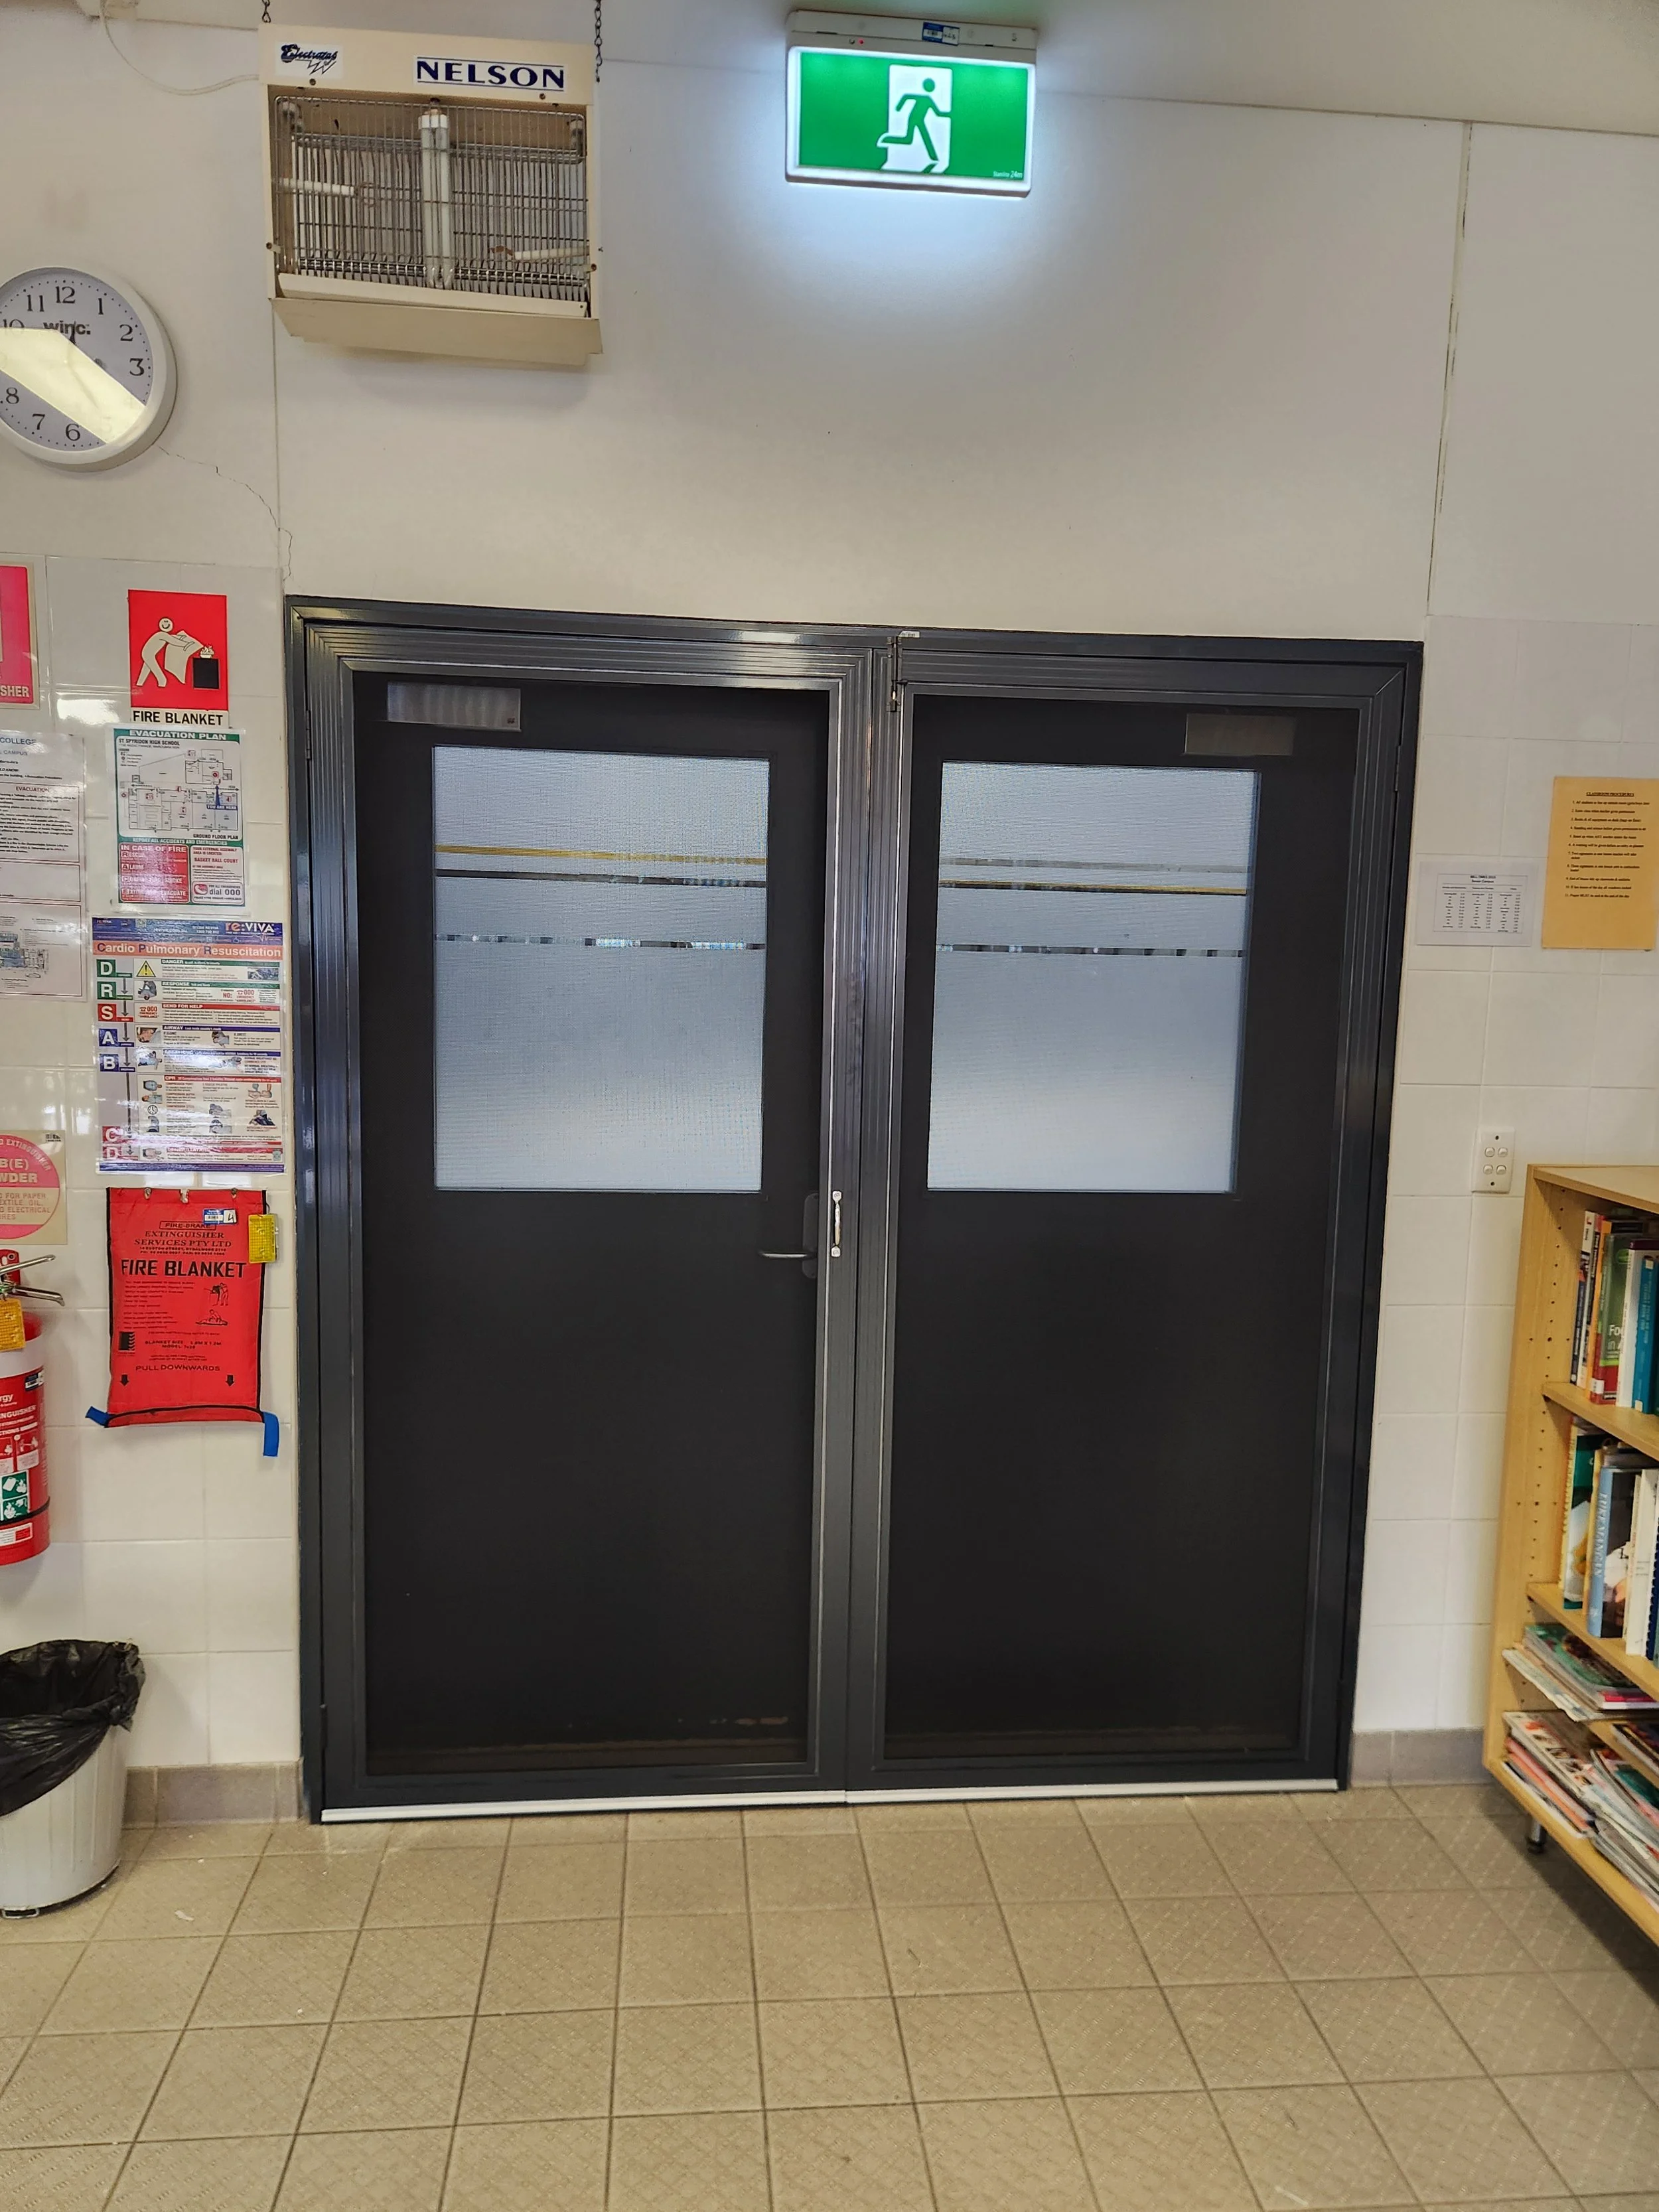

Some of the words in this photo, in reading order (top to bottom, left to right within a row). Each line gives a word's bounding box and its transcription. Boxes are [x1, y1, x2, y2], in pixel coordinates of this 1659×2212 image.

[416, 60, 564, 88] NELSON
[56, 286, 76, 303] 12
[27, 295, 44, 312] 11
[98, 298, 104, 315] 1
[119, 324, 133, 341] 2
[129, 358, 145, 376] 3
[6, 387, 19, 404] 8
[33, 413, 45, 430] 7
[66, 423, 80, 441] 6
[133, 710, 160, 723] FIRE
[165, 712, 223, 725] BLANKET
[129, 730, 195, 739] EVACUATION
[97, 942, 135, 952] Cardio
[139, 944, 200, 956] Pulmonary
[204, 946, 281, 956] Resuscitation
[100, 961, 113, 976] D
[101, 984, 113, 997] R
[101, 1005, 113, 1020] S
[102, 1031, 115, 1045] A
[104, 1056, 115, 1070] B
[121, 1259, 158, 1276] FIRE
[164, 1260, 246, 1278] BLANKET
